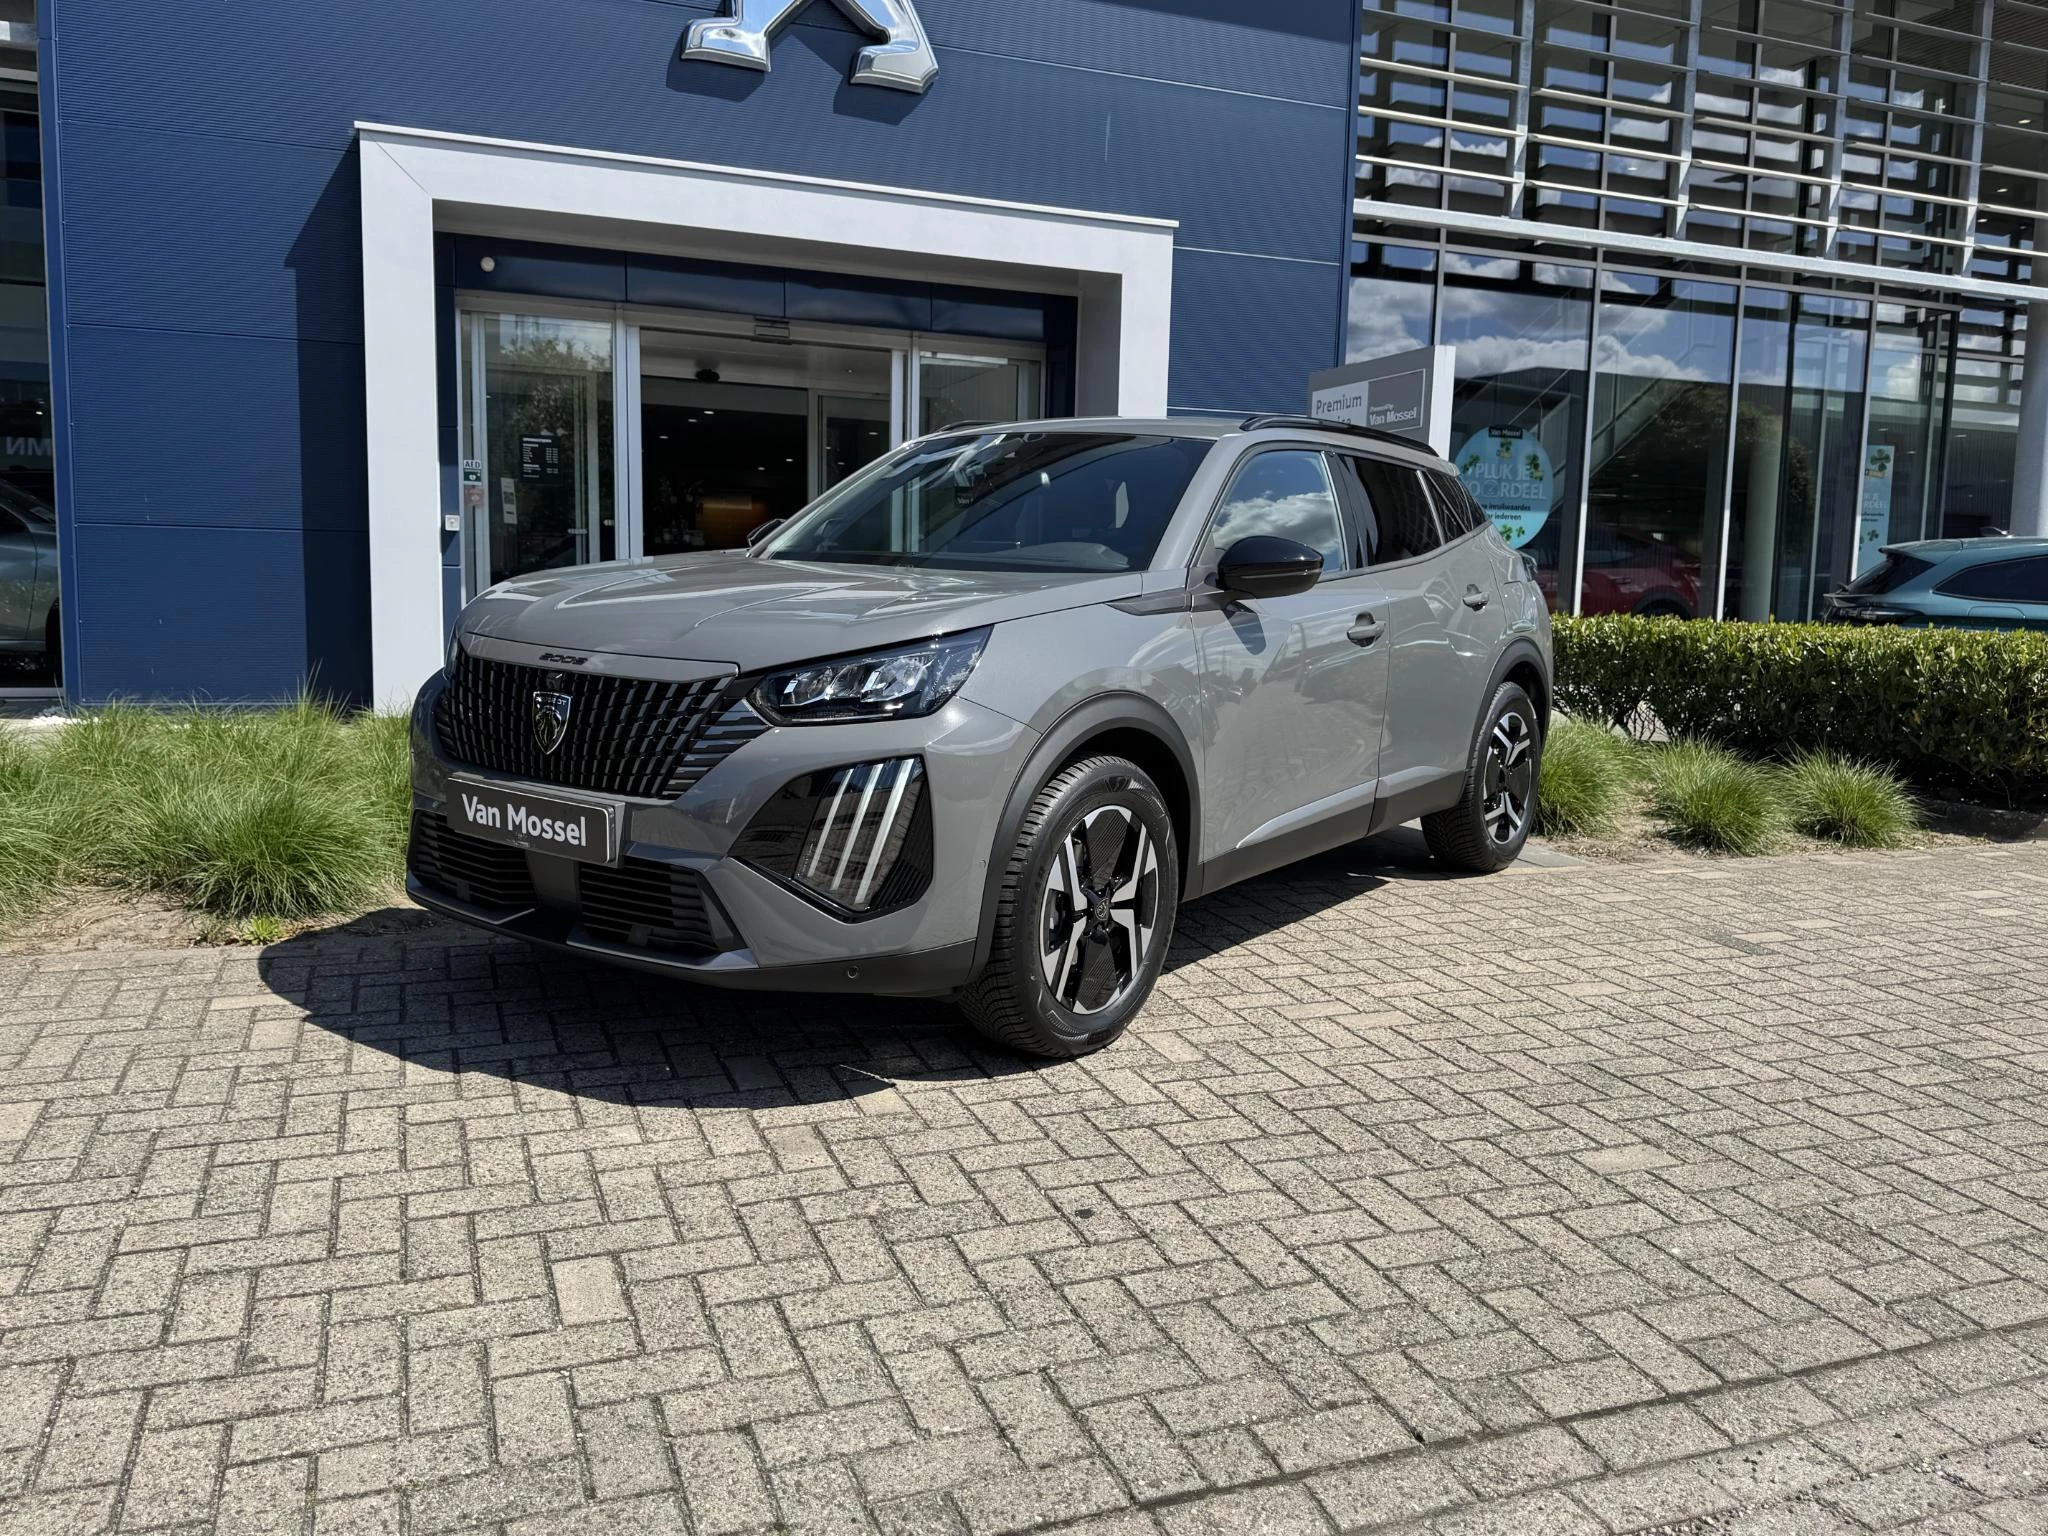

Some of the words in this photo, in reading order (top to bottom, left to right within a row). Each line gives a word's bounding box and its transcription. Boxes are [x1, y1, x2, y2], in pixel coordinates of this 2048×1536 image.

[1316, 394, 1362, 414] Premium
[1369, 414, 1385, 426] Van
[1386, 406, 1417, 423] Mossel
[464, 461, 481, 469] AED
[1475, 463, 1513, 480] PLUK
[1516, 464, 1531, 481] JE
[1494, 512, 1522, 520] iedereen
[461, 793, 501, 828] Van
[507, 803, 587, 847] Mossel
